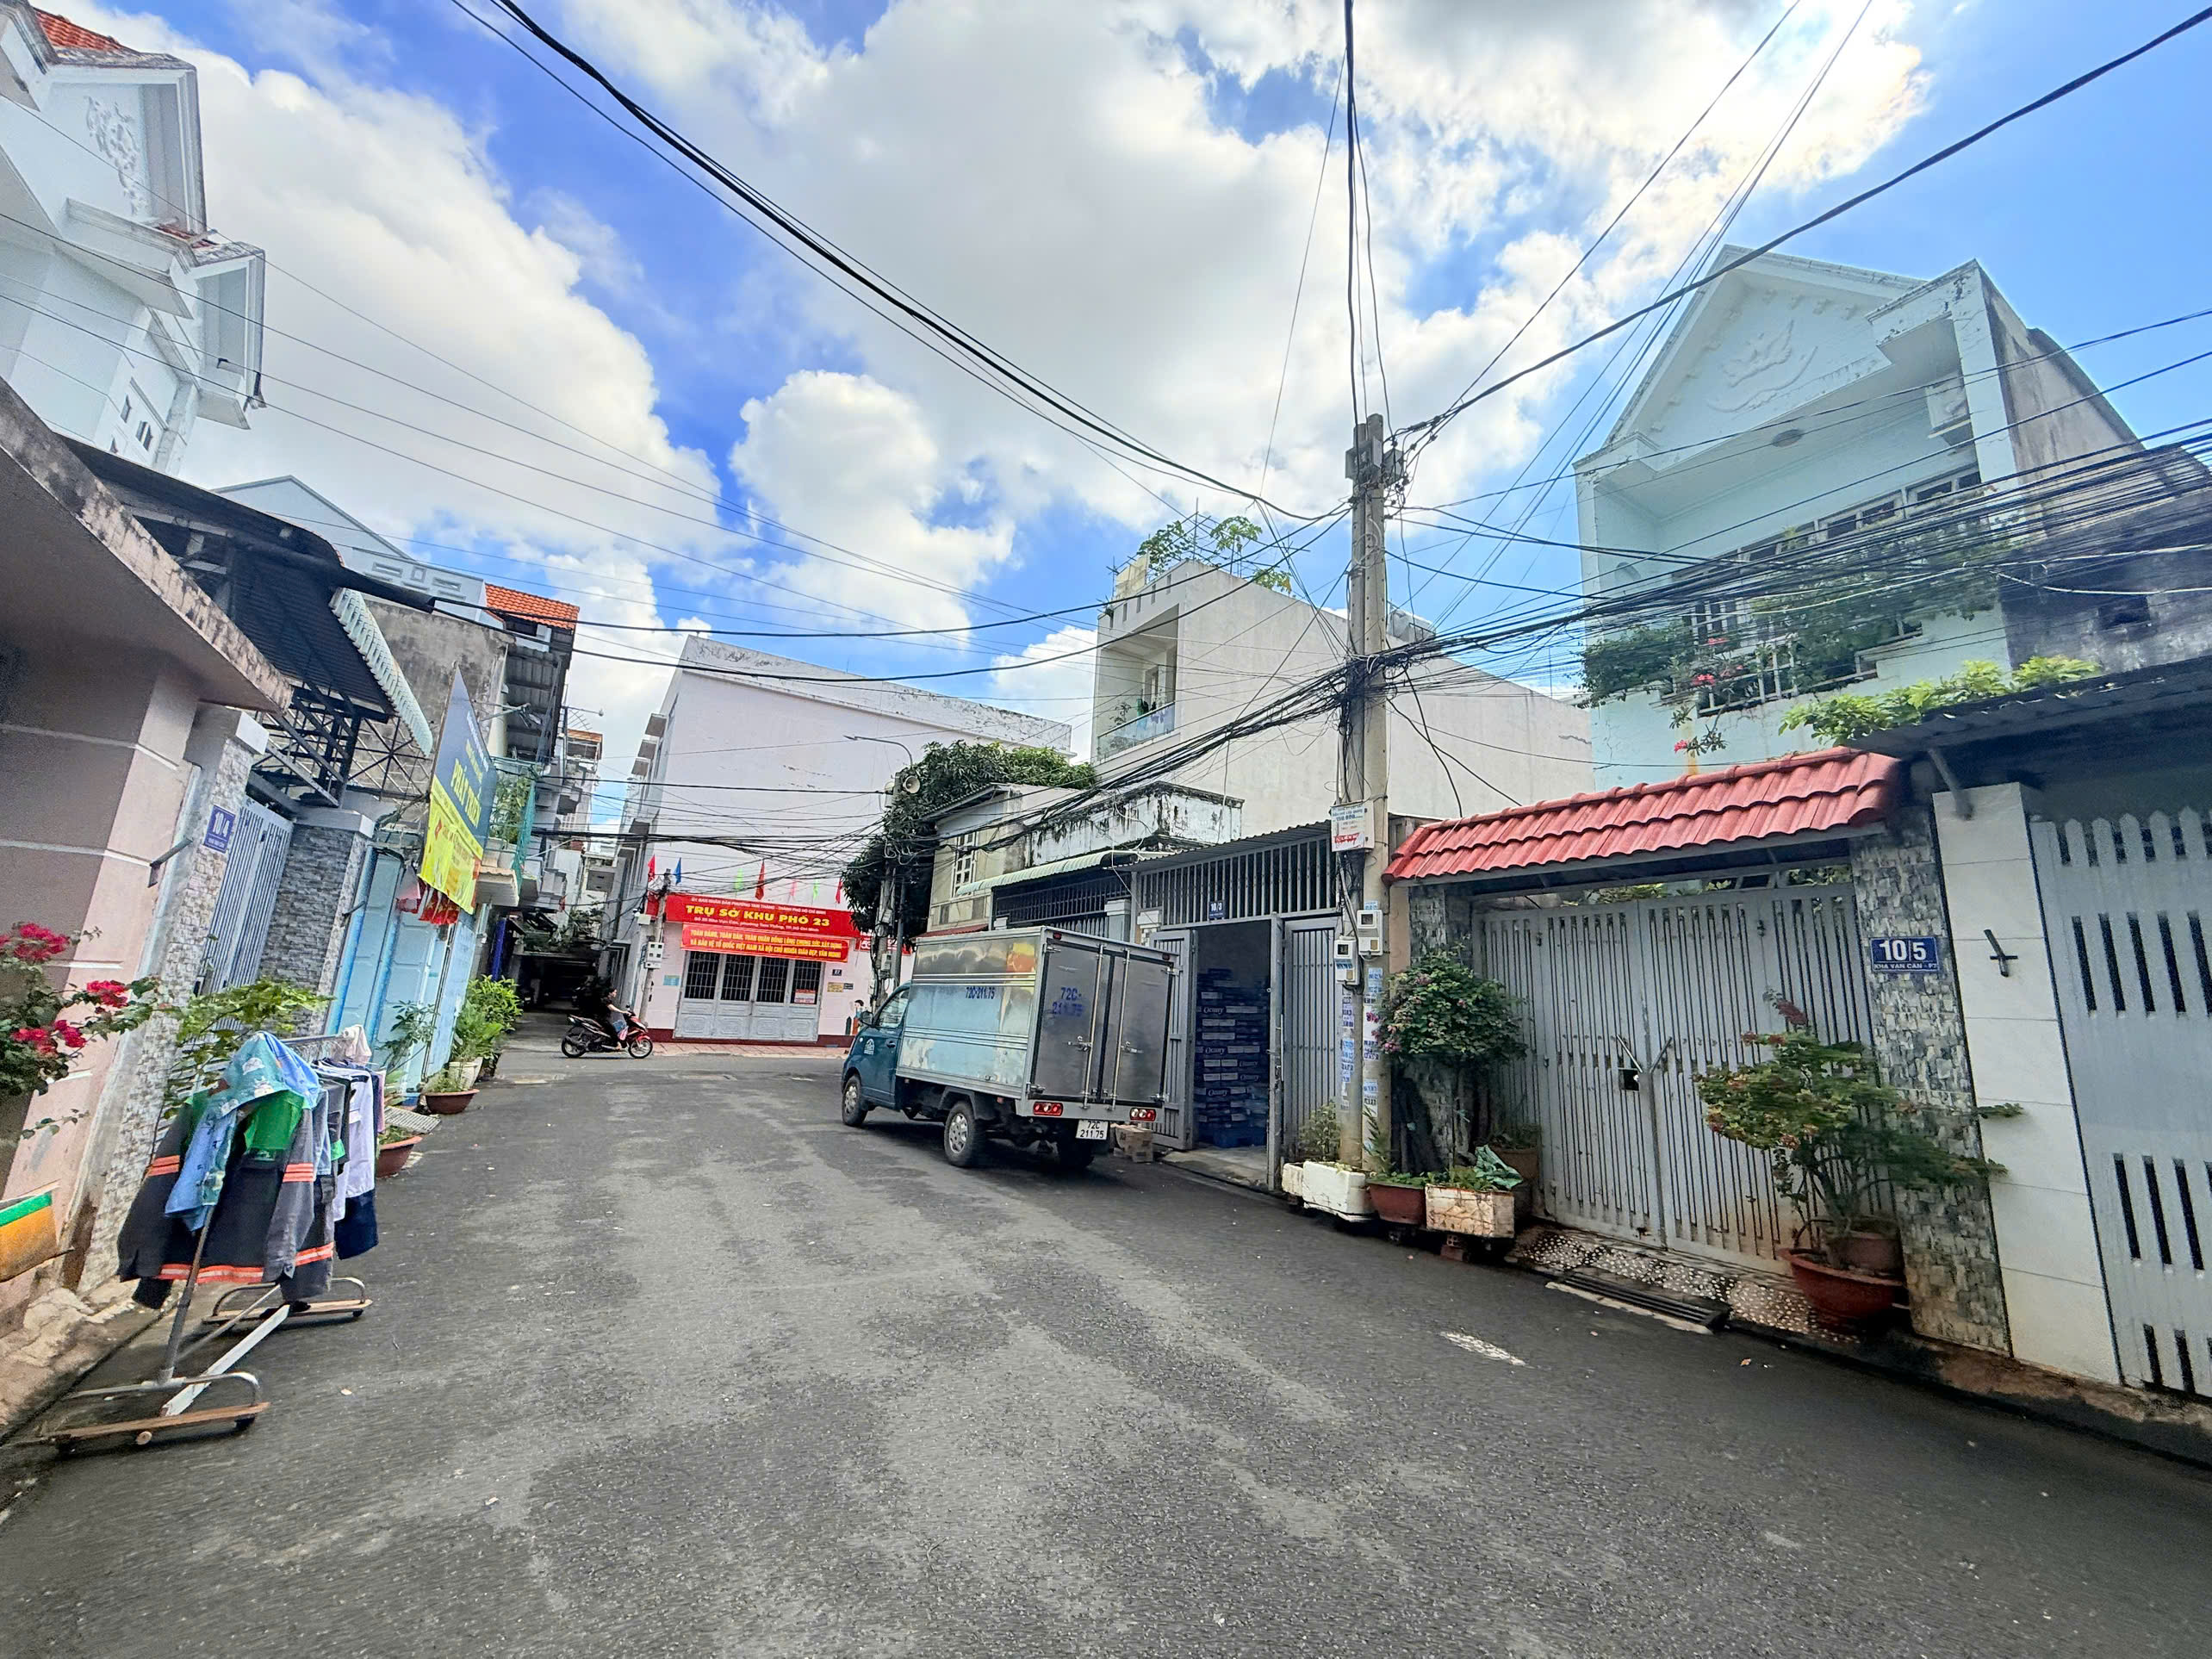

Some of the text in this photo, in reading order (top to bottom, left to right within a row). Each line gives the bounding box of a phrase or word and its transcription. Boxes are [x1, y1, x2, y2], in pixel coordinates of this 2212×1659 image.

[686, 905, 830, 926] TRỤ SỞ KHU PHỐ 23
[1088, 1121, 1101, 1129] 72C
